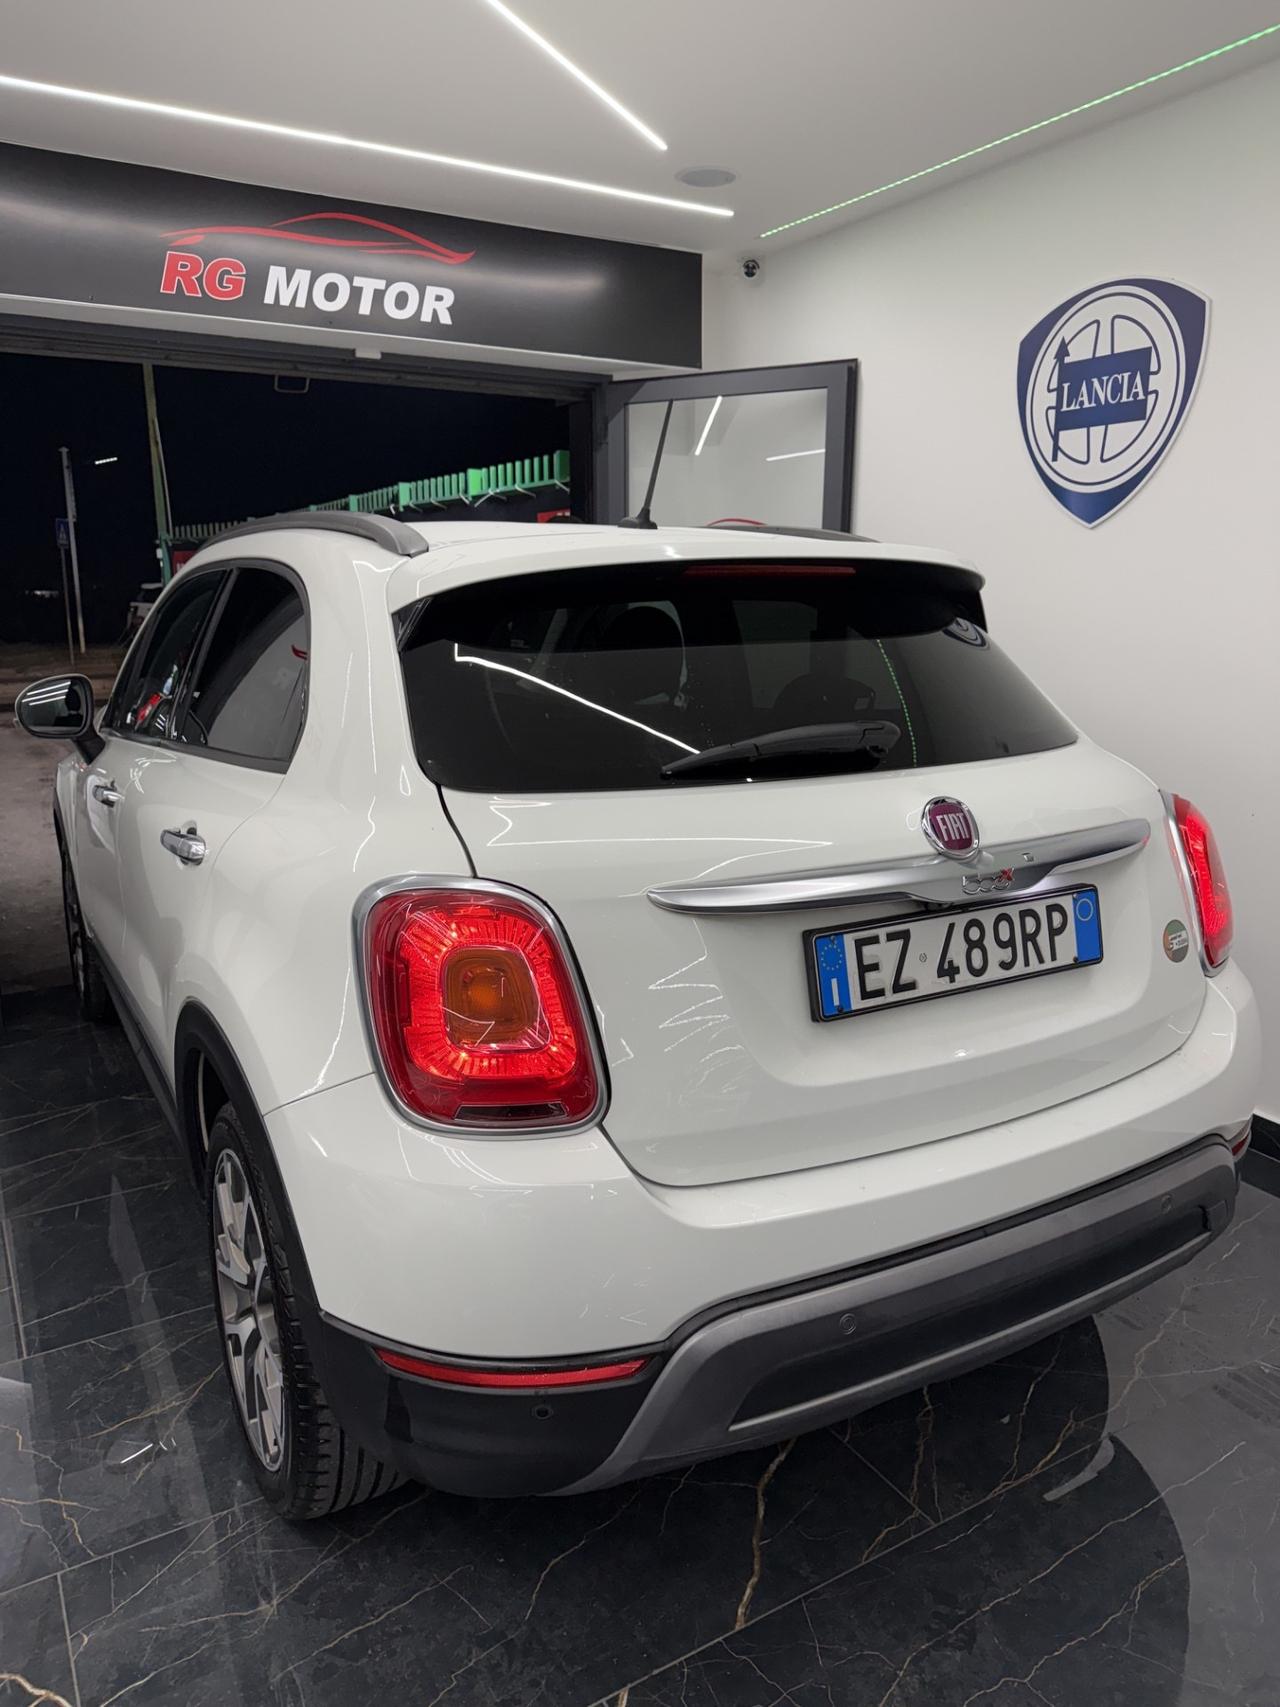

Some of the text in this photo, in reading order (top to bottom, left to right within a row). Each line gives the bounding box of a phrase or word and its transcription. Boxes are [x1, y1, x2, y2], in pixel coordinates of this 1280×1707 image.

[160, 251, 455, 325] RG MOTOR
[1060, 370, 1146, 412] LANCIA
[936, 812, 970, 842] FIAT
